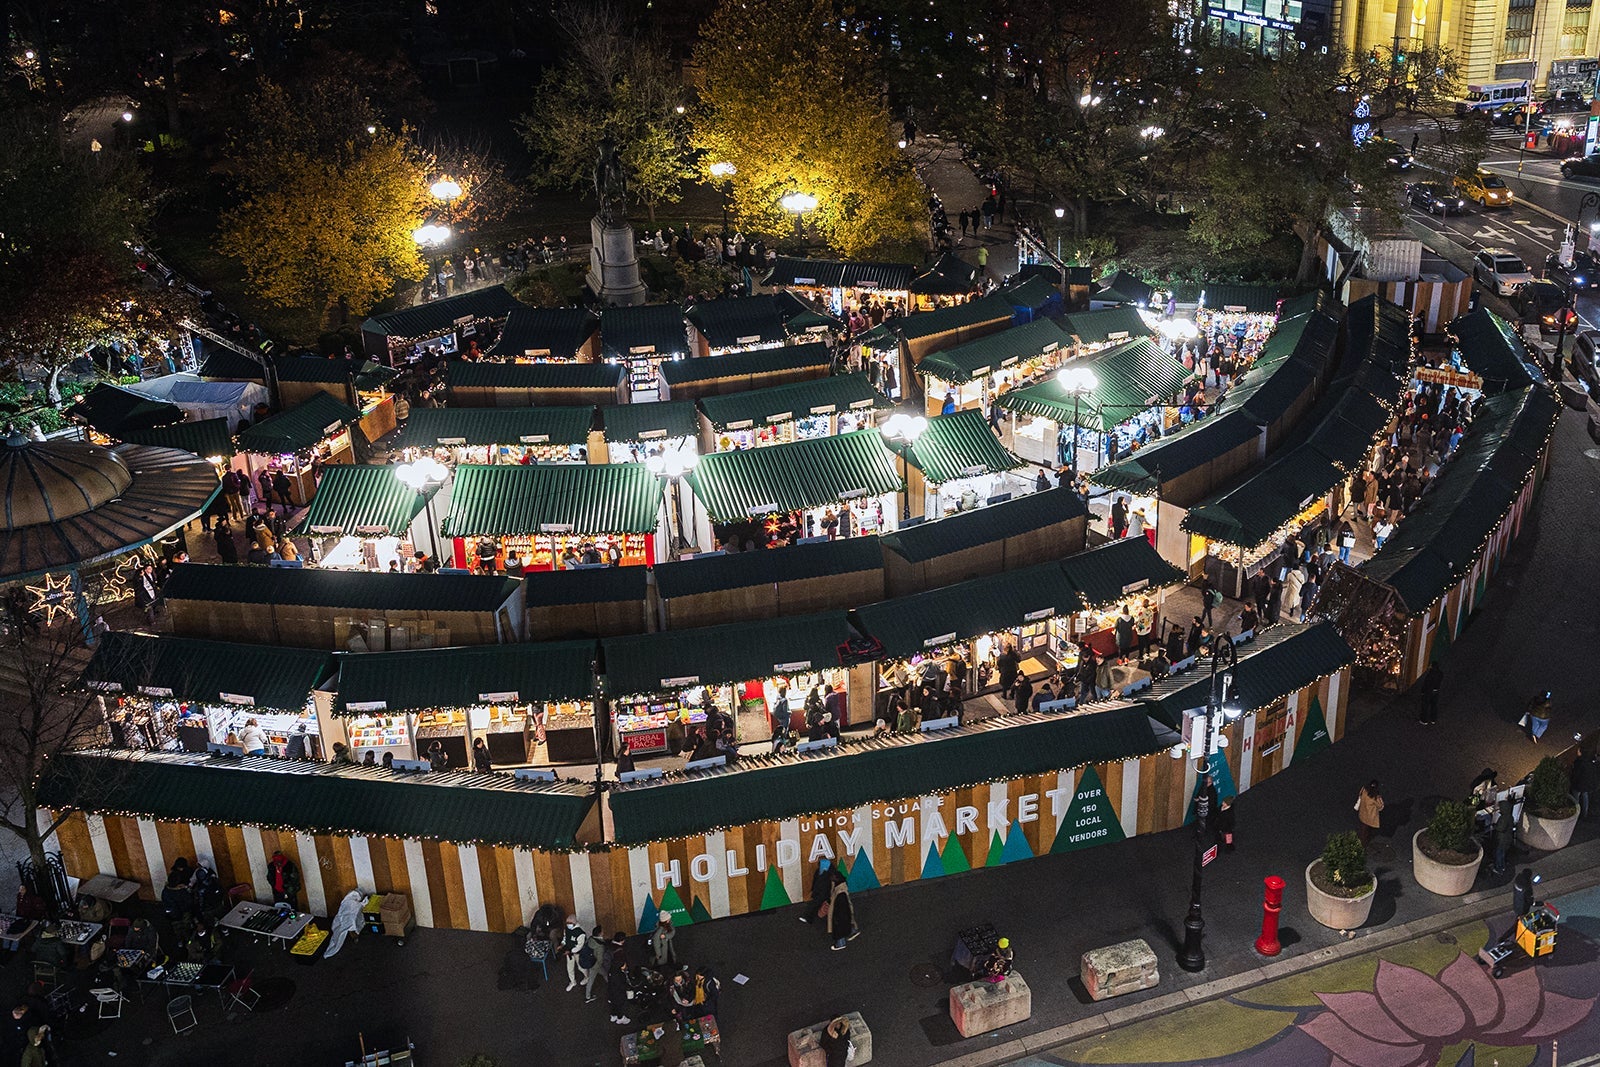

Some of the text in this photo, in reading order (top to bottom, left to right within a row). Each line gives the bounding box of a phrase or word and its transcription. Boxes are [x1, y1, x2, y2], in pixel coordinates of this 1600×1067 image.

[627, 734, 661, 743] HERBAL
[633, 740, 656, 748] PACS
[1077, 788, 1102, 800] OVER
[1081, 804, 1097, 813] 150
[801, 797, 946, 833] UNION SQUARE
[1075, 816, 1102, 827] LOCAL
[655, 788, 1067, 890] HOLIDAY MARKET
[1069, 828, 1108, 843] VENDORS
